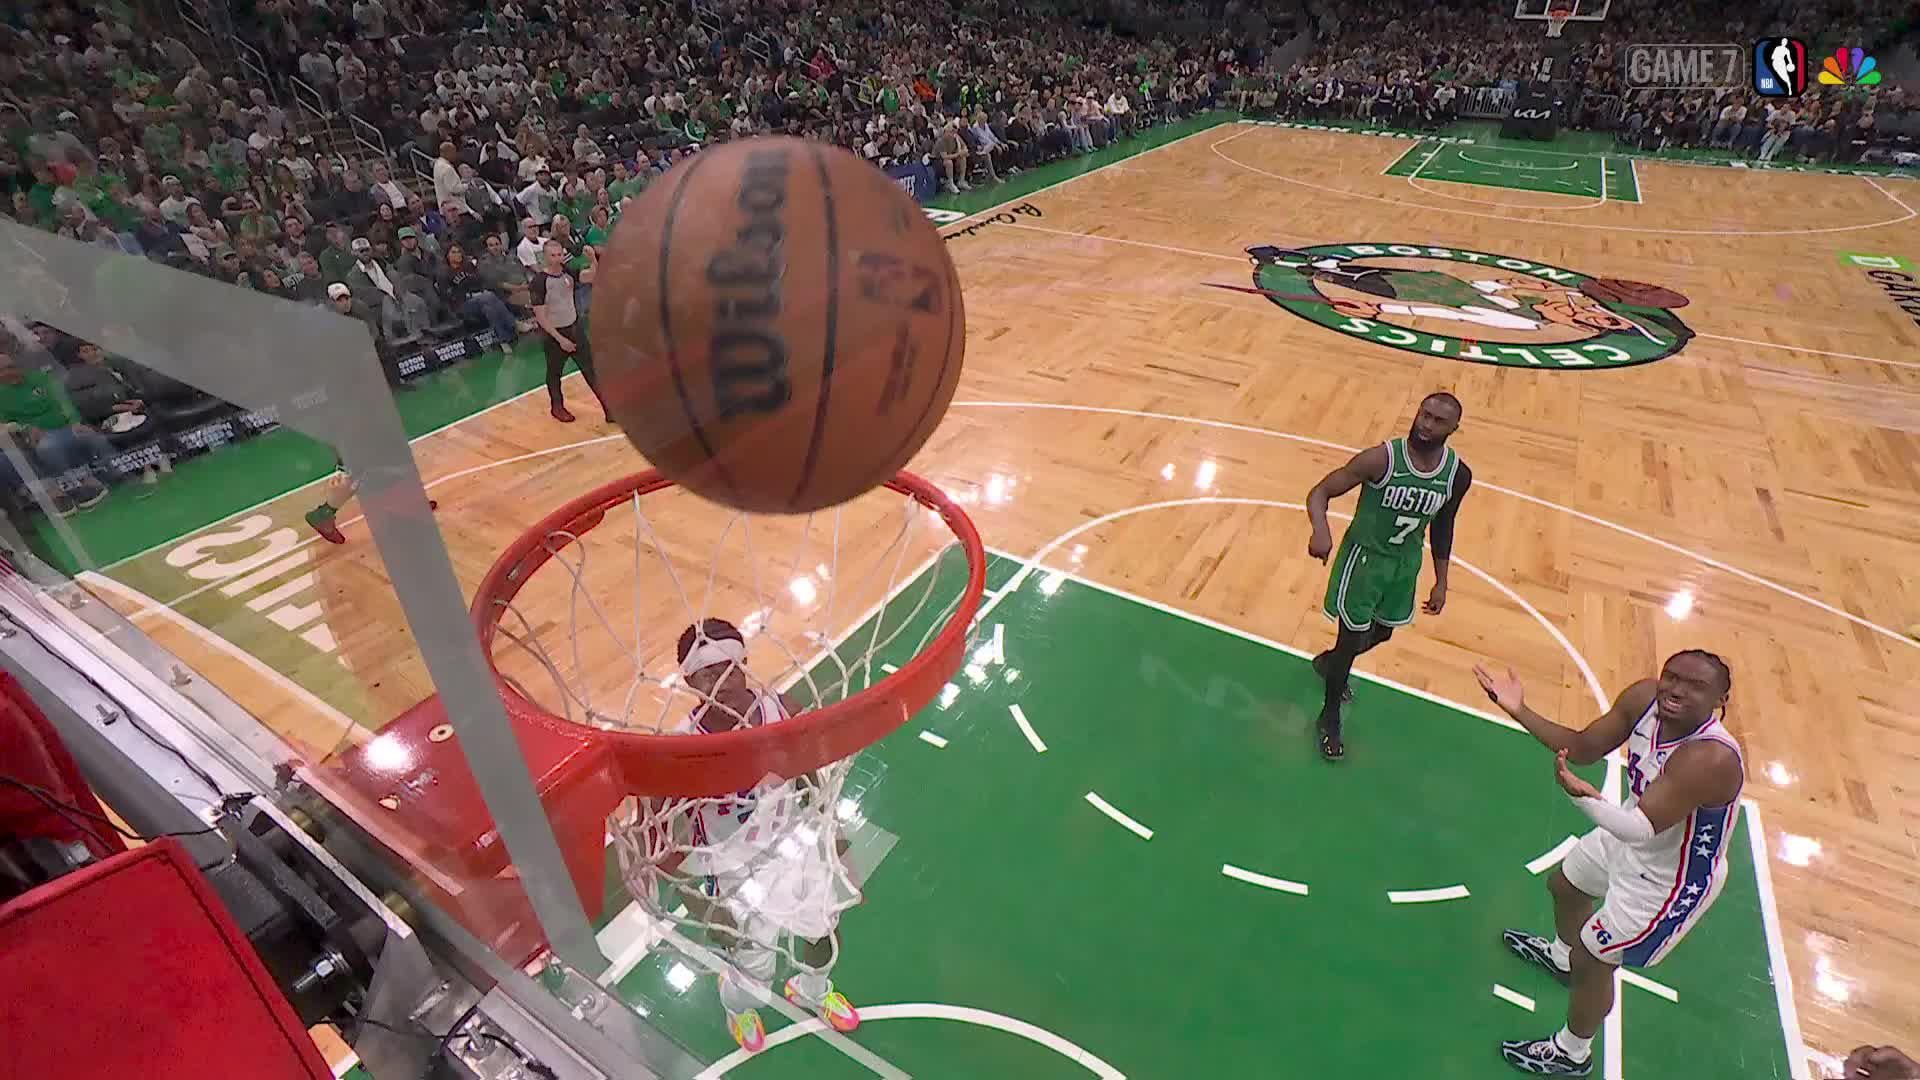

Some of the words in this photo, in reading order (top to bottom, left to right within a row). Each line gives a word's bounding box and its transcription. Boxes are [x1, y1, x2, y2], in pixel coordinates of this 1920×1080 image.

[1348, 245, 1574, 281] BOSTON
[707, 149, 792, 418] Wilson
[434, 341, 465, 356] BOSTON
[440, 348, 466, 361] CELTICS
[1340, 318, 1632, 367] CELTICS
[398, 355, 425, 369] OSTON
[1381, 486, 1446, 515] BOSTON
[1388, 515, 1420, 544] 7
